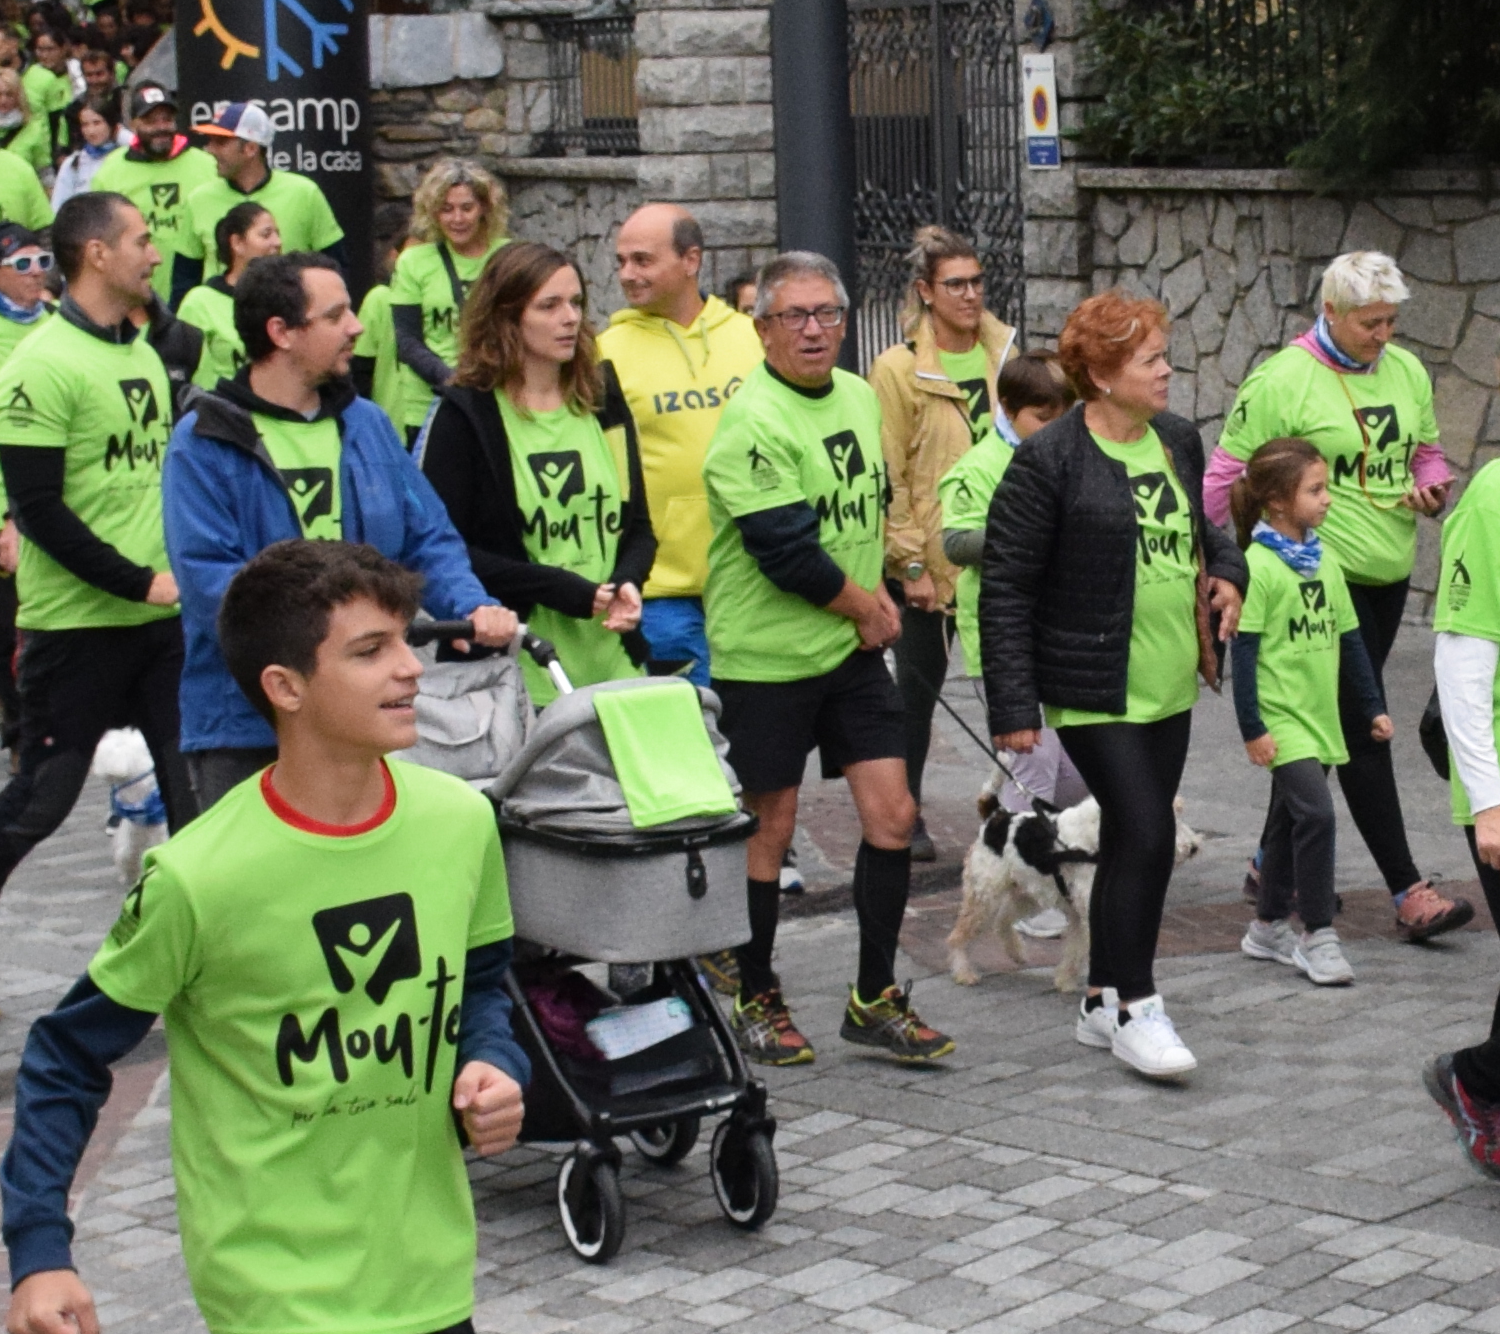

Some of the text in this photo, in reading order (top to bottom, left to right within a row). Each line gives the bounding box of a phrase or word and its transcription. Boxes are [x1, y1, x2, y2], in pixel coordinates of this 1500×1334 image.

[297, 144, 318, 171] la
[320, 151, 363, 172] casa
[1334, 433, 1415, 488] Mou-t
